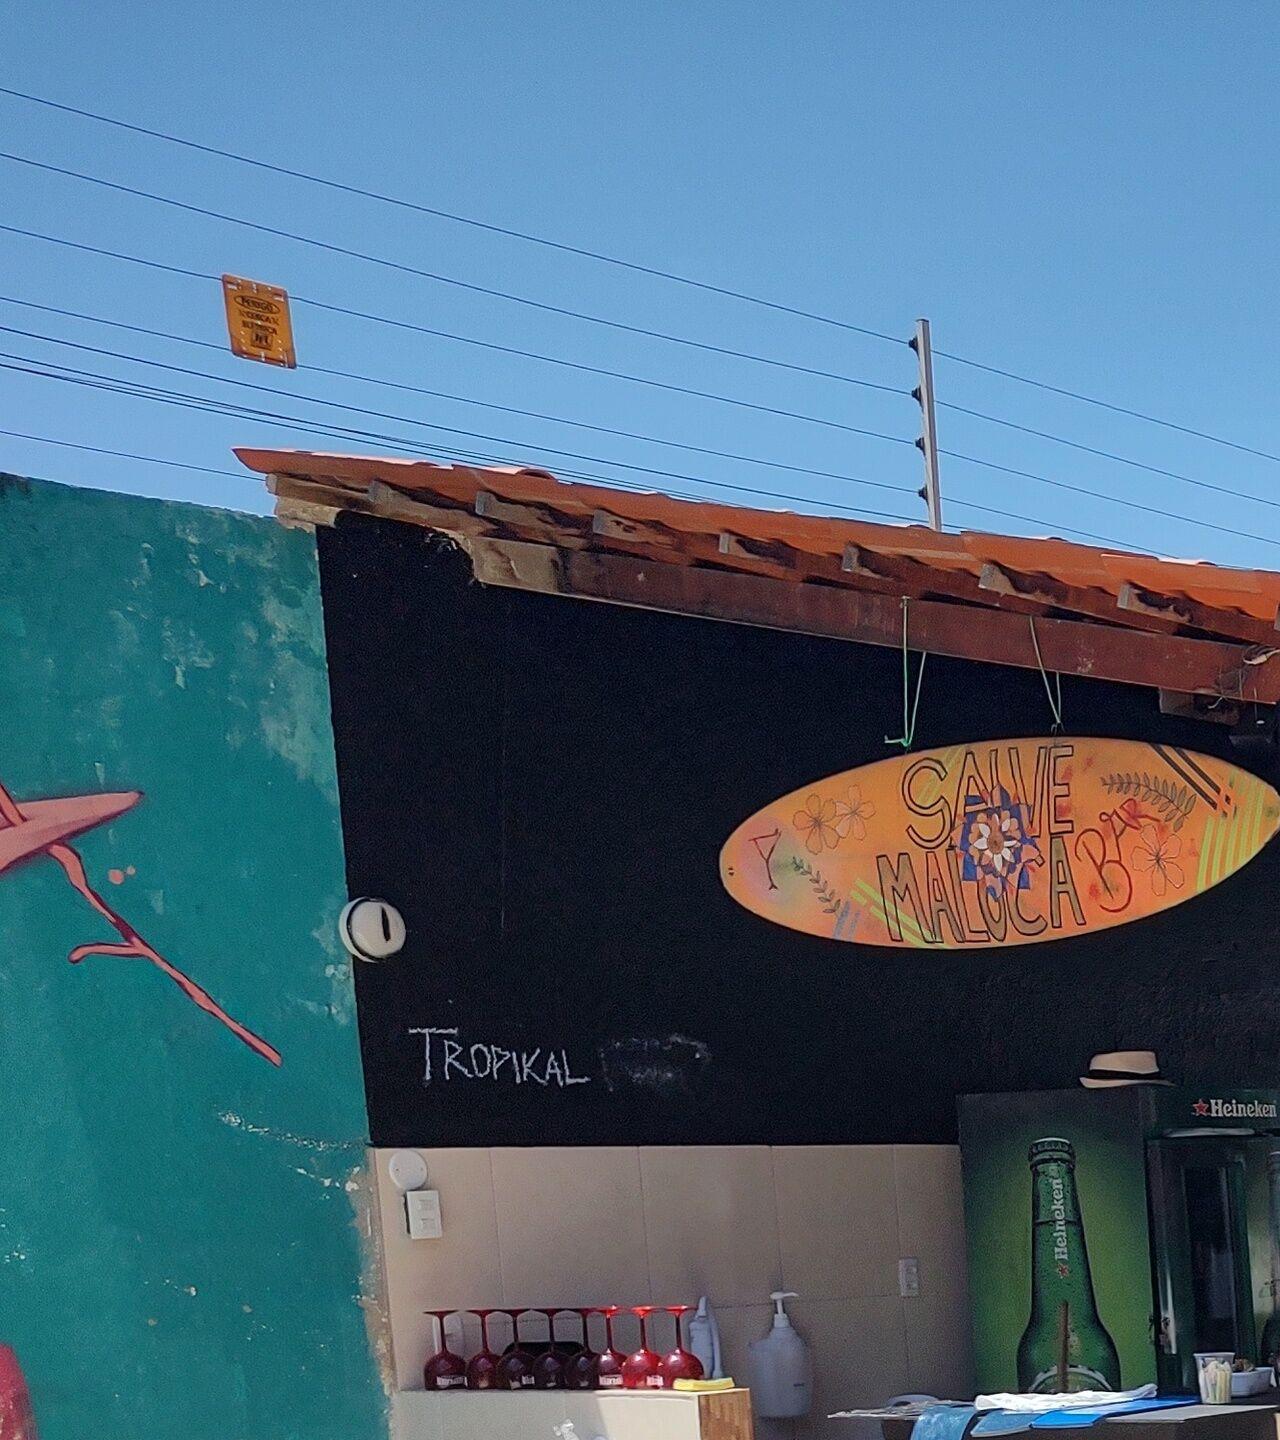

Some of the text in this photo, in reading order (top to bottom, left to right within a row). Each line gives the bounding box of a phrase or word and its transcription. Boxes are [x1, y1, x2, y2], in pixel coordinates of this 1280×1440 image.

[876, 836, 1086, 944] MALOCA
[1210, 1099, 1277, 1117] Heineken
[1051, 1178, 1069, 1260] Heineken
